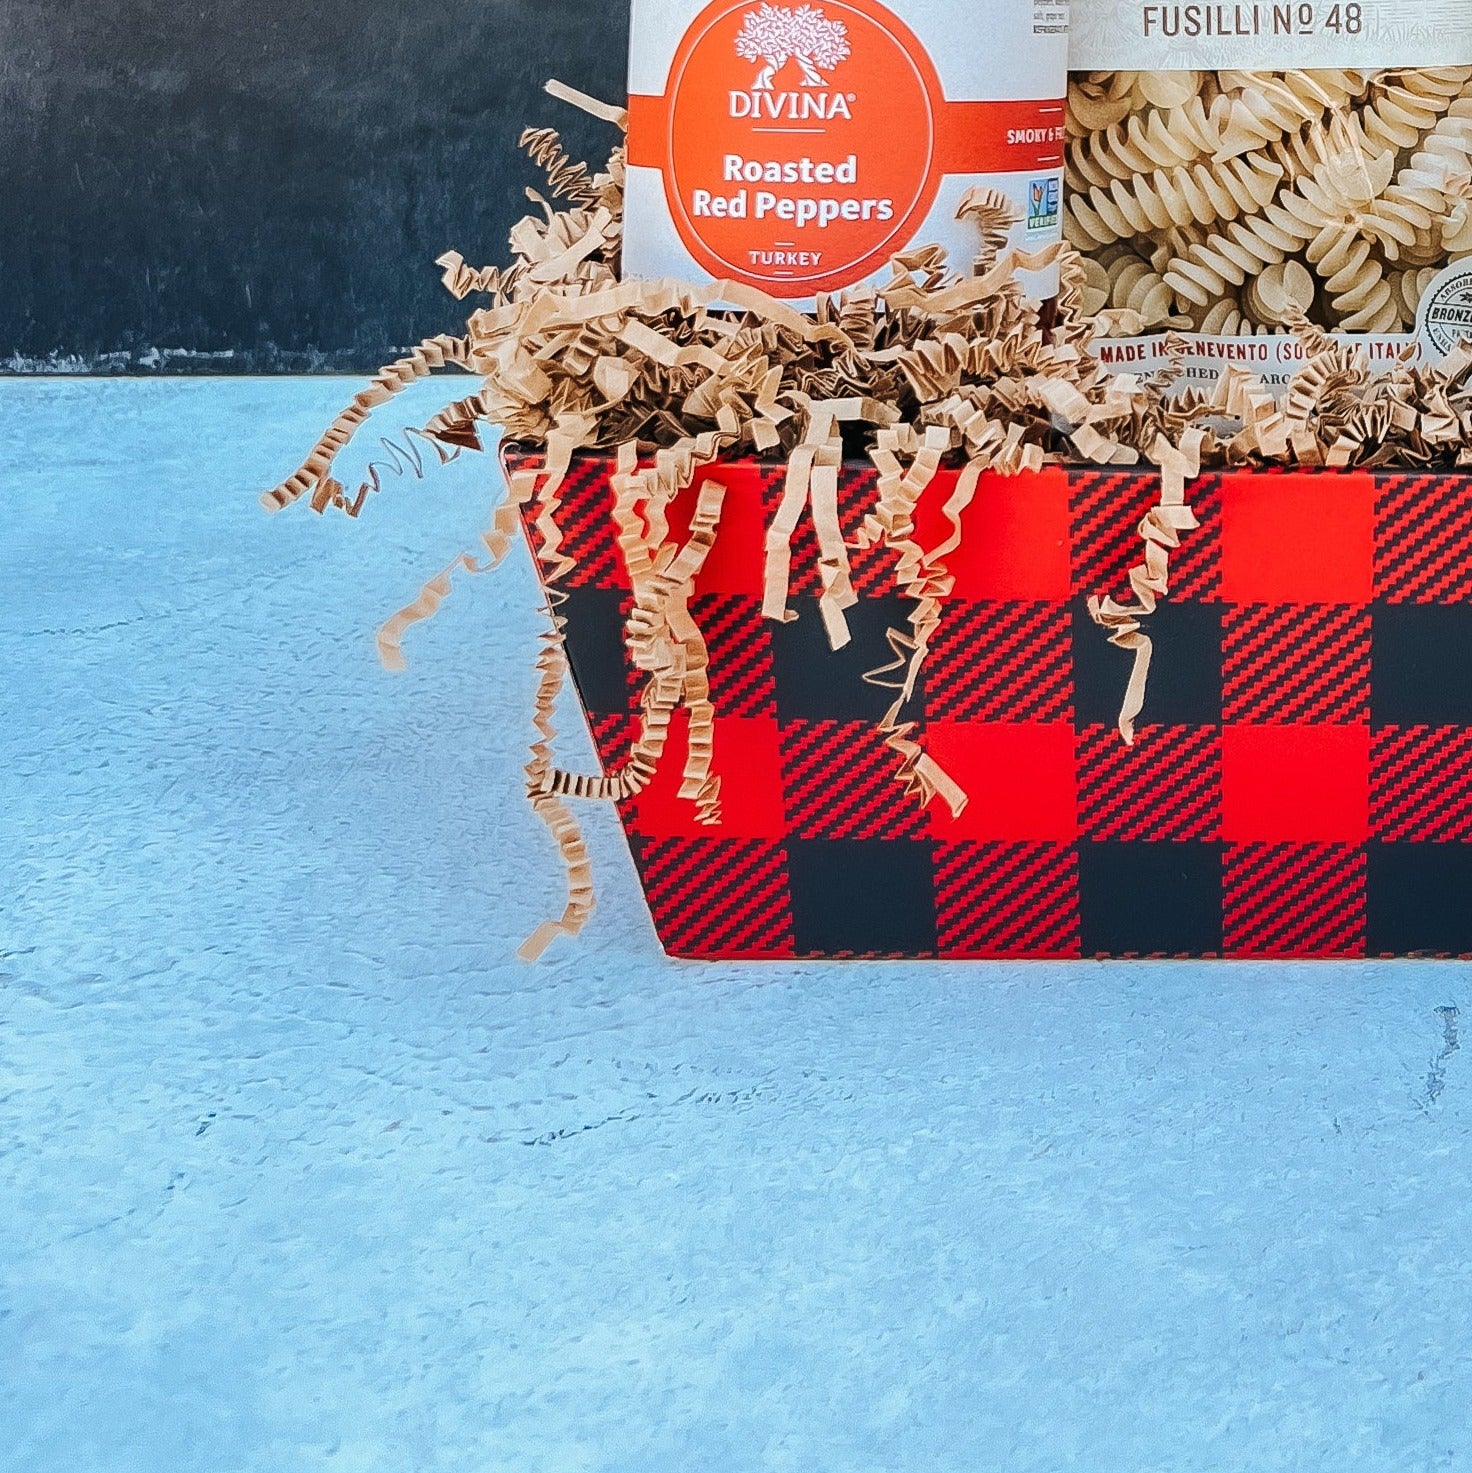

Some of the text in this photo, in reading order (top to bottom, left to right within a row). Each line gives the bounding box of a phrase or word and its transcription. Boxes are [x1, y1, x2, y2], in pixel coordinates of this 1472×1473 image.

[1143, 5, 1261, 37] FUSILLI
[1325, 2, 1363, 34] 48
[729, 90, 853, 120] DIVINA
[1007, 127, 1047, 145] SMOKY
[723, 154, 857, 184] Roasted
[693, 189, 894, 227] Red Peppers
[749, 250, 823, 267] TURKEY
[1101, 344, 1146, 363] MADE
[1152, 342, 1168, 357] IN
